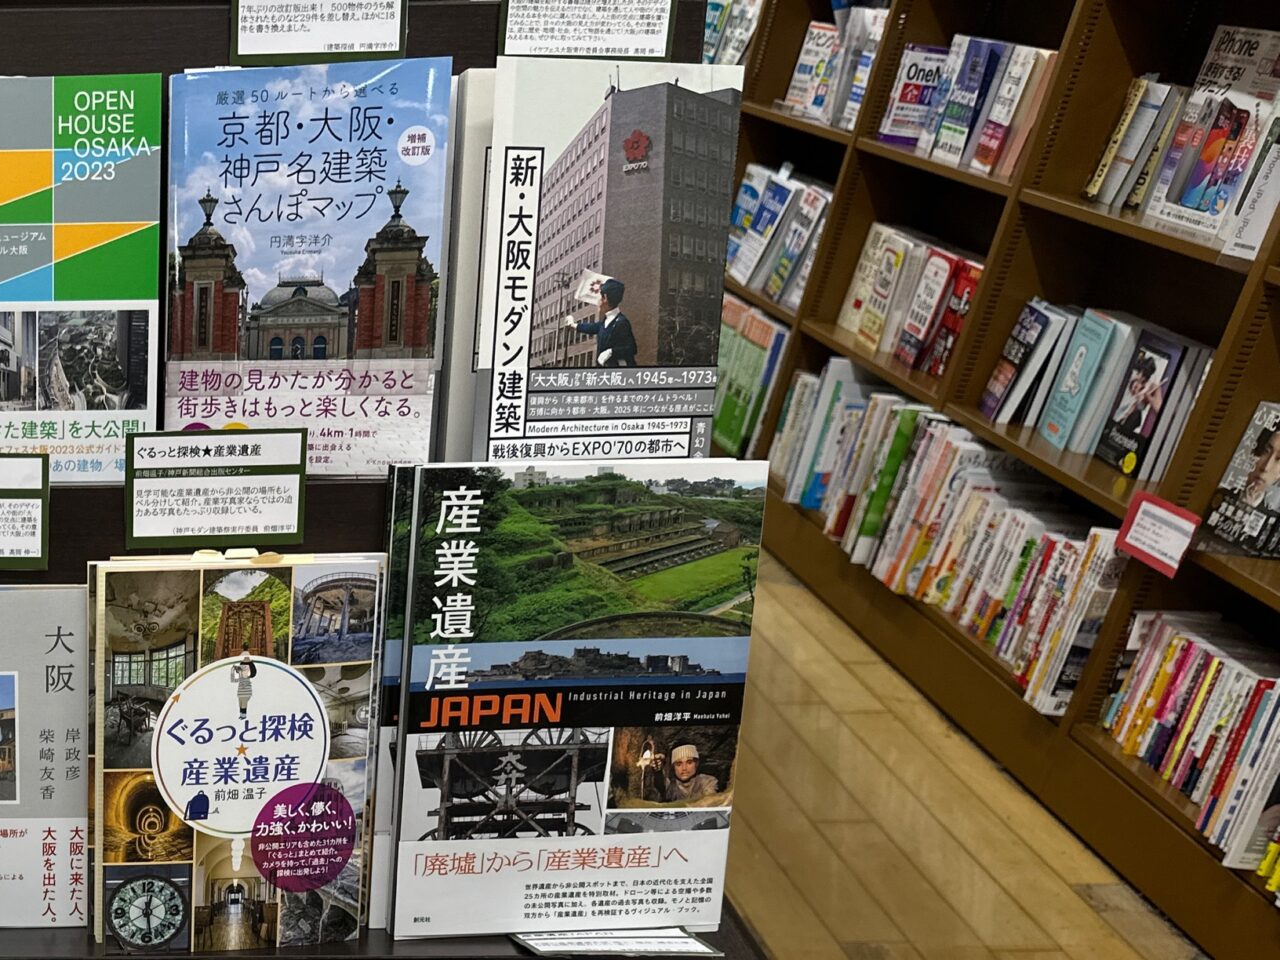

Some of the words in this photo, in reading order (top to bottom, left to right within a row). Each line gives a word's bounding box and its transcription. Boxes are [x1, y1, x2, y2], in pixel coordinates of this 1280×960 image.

[74, 90, 135, 111] OPEN
[58, 114, 135, 135] HOUSE
[407, 133, 427, 144] 増補
[74, 137, 152, 158] OSAKA
[401, 145, 431, 157] 改訂版
[61, 162, 116, 181] 2023
[218, 147, 387, 188] 神戸名建築
[223, 186, 384, 224] さんぽマップ
[494, 154, 538, 434] 新・大阪モダン建築
[178, 368, 415, 392] 建物の見かたが分かると
[528, 424, 558, 434] Modern
[560, 422, 609, 432] Architecture
[611, 422, 619, 431] in
[621, 421, 645, 431] Osaka
[424, 485, 484, 692] 産業遺産
[44, 625, 75, 694] 大阪
[420, 692, 563, 728] JAPAN
[568, 691, 624, 702] Industrial
[629, 689, 675, 703] Heritage
[681, 689, 692, 700] in
[695, 688, 727, 702] Japan
[166, 712, 315, 746] ぐるっと探検
[39, 728, 55, 801] 柴崎友香
[65, 728, 81, 780] 岸政彦
[180, 753, 301, 787] 産業遺産
[142, 881, 155, 893] 12
